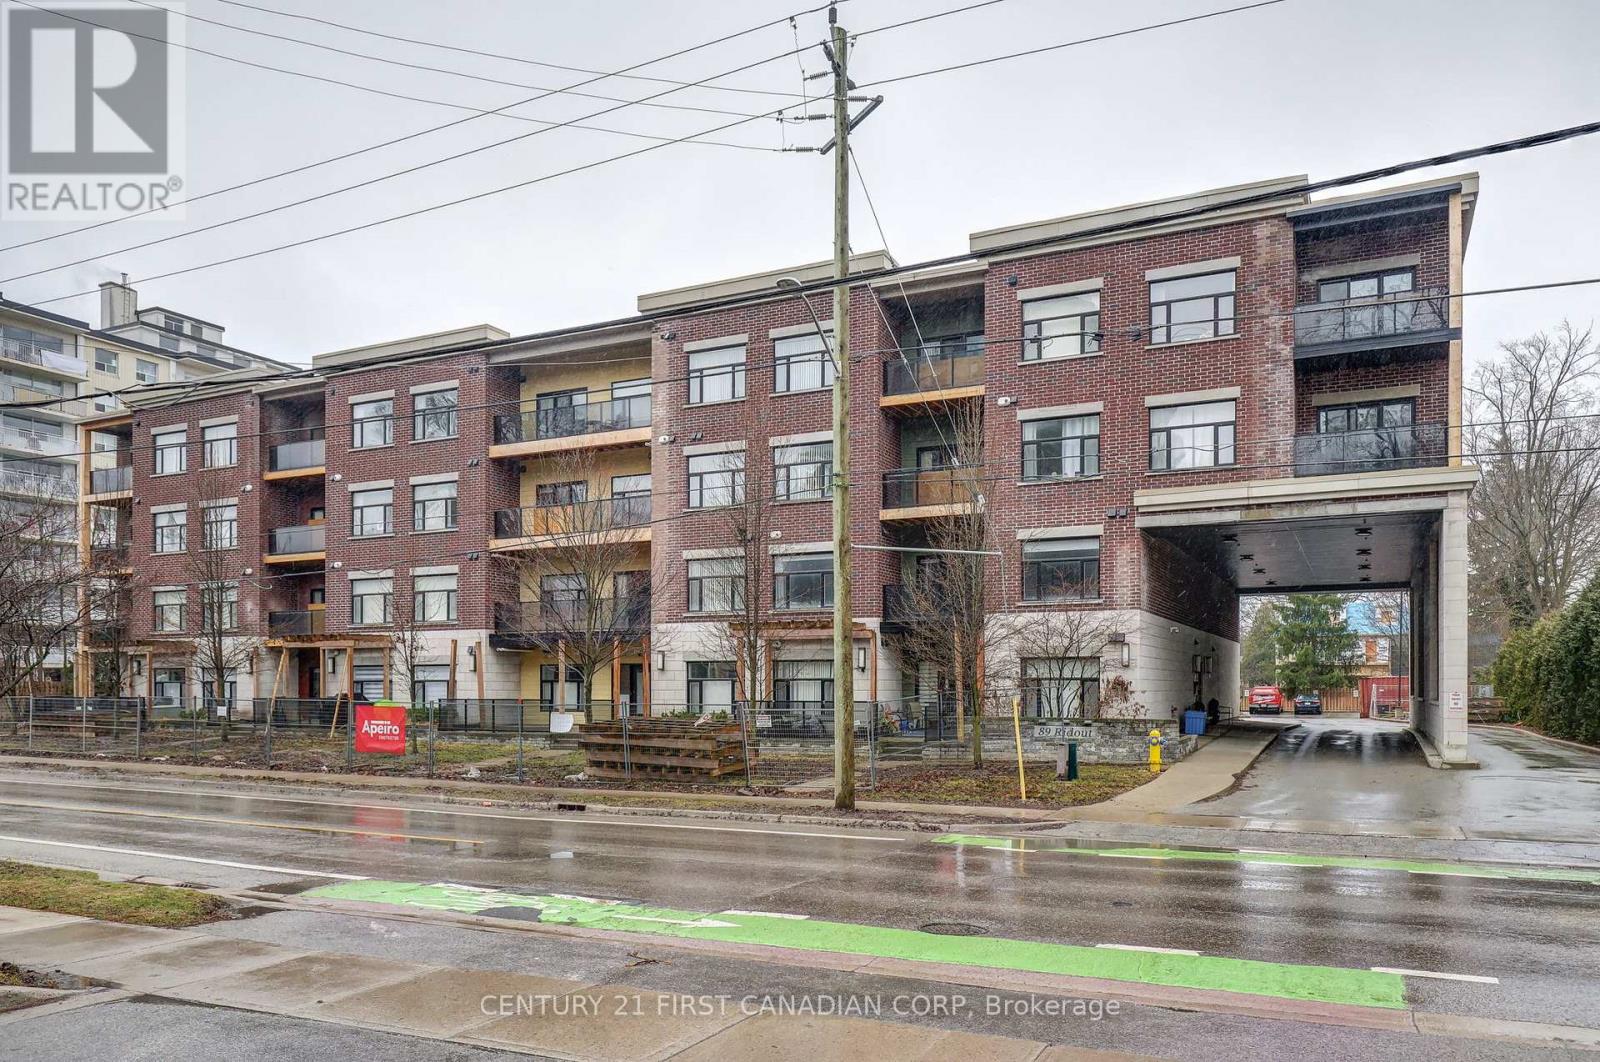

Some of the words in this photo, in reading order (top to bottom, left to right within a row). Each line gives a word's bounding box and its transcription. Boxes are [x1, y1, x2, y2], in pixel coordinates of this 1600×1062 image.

[361, 719, 399, 737] Apeiro
[1038, 727, 1051, 738] 89
[1055, 727, 1092, 738] Ridout
